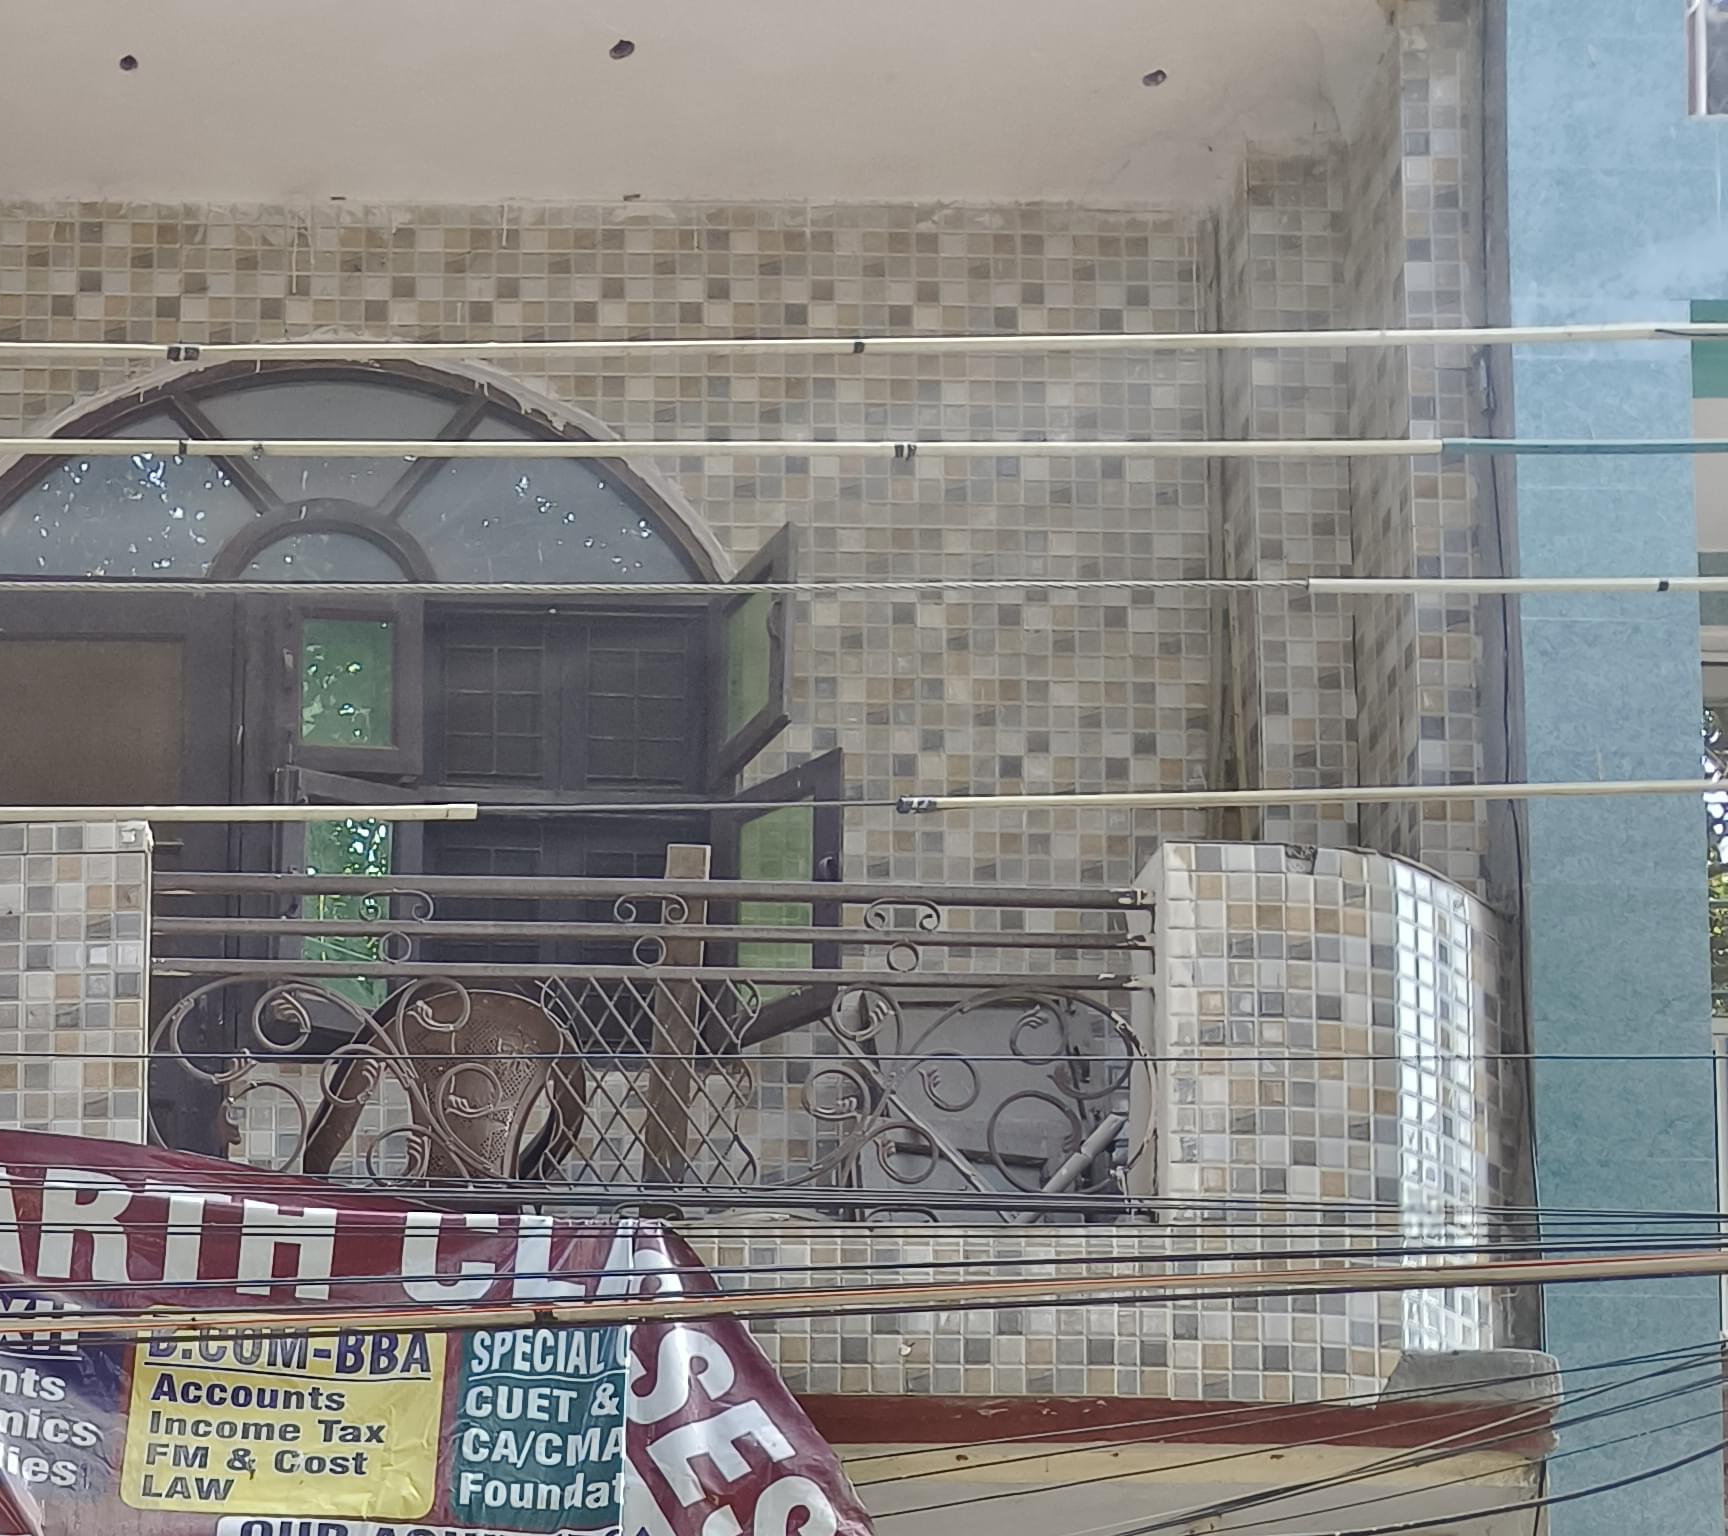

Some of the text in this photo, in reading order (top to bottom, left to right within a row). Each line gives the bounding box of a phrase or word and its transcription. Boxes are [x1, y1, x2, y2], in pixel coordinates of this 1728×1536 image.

[471, 1329, 603, 1376] SPECIAL
[151, 1374, 345, 1411] Accounts
[465, 1382, 620, 1423] CUET &
[149, 1411, 385, 1444] Income Tax
[146, 1443, 208, 1469] FM
[274, 1448, 368, 1475] Cost
[142, 1475, 234, 1501] LAW
